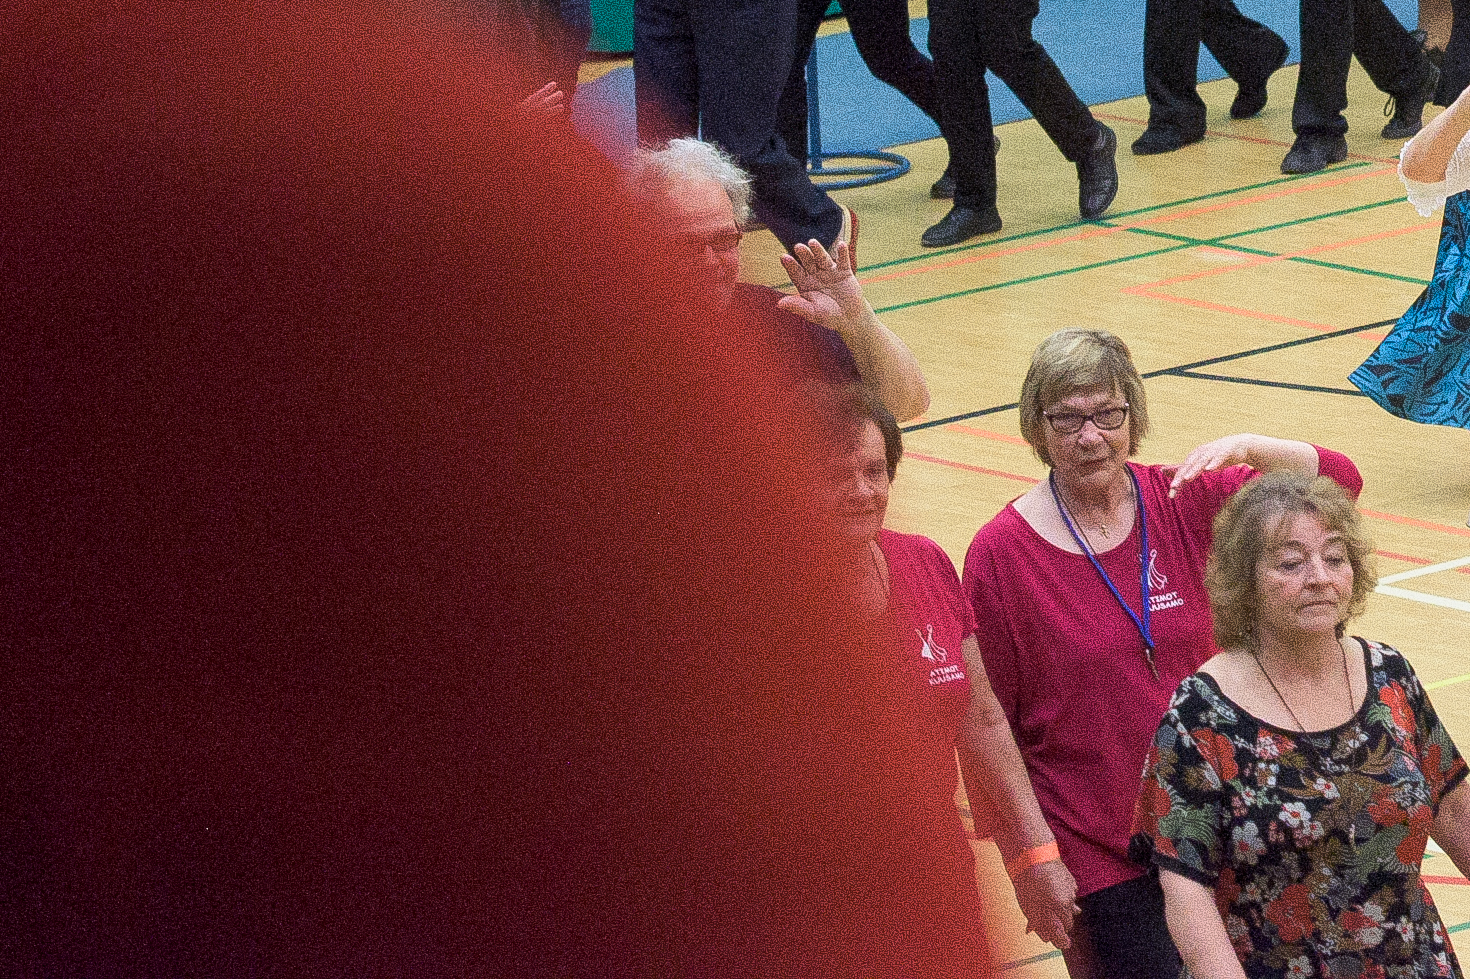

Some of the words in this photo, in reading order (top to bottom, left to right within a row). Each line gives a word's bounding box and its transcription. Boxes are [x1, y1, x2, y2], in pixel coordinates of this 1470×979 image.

[1148, 591, 1178, 604] TIMOT
[1148, 598, 1185, 612] UUSAMO
[929, 664, 959, 678] ATIMOT
[928, 671, 965, 686] KUUSAMO
